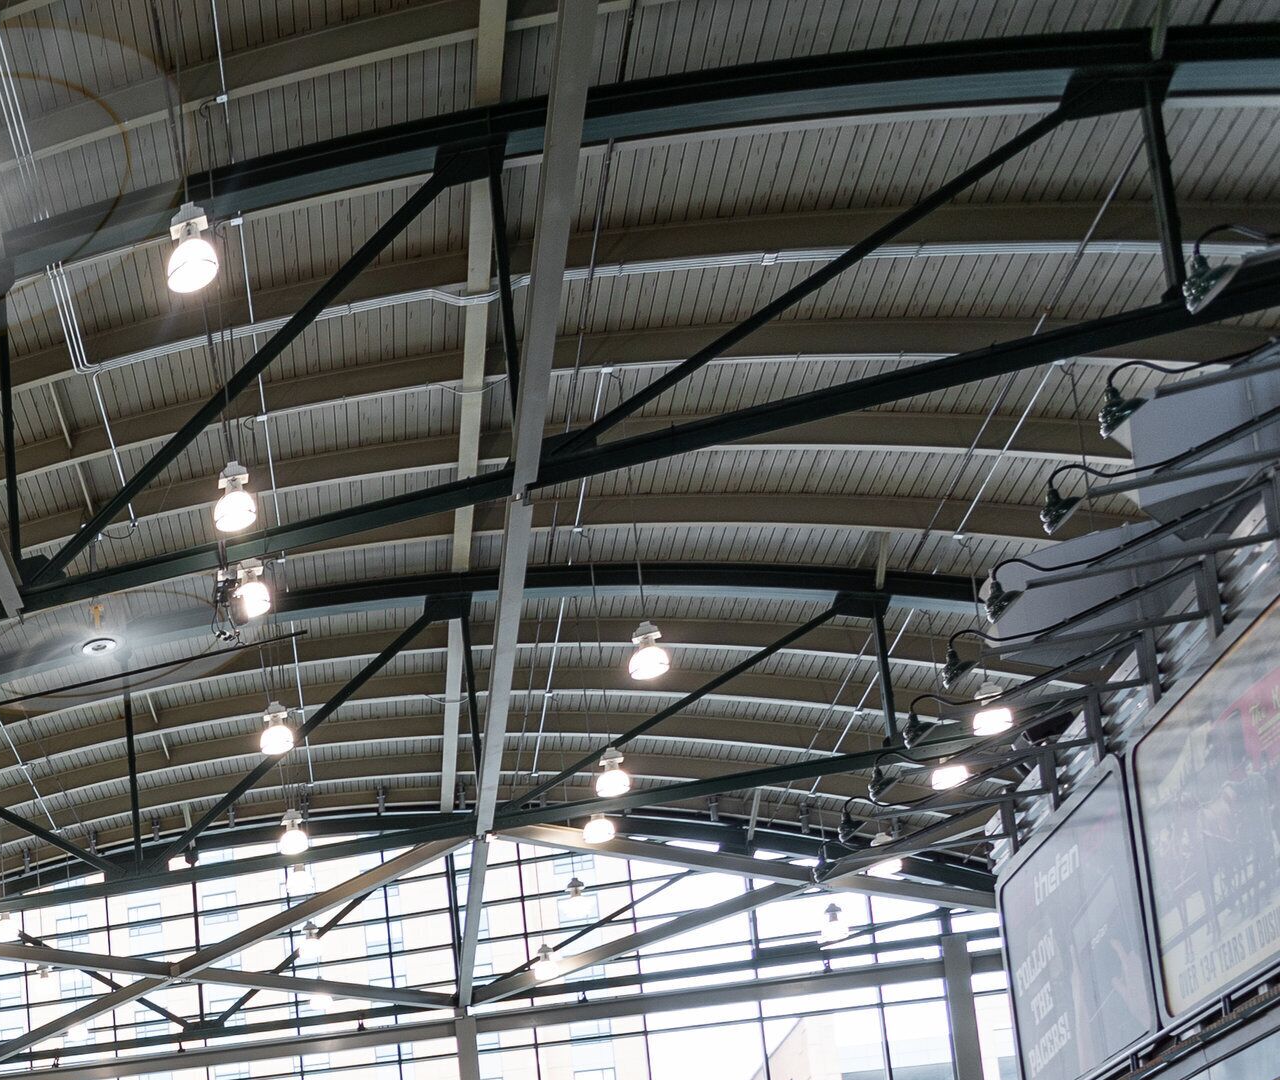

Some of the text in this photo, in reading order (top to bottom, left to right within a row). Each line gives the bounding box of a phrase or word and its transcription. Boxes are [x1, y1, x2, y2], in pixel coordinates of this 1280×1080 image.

[1015, 927, 1056, 998] FOLLOW
[1030, 981, 1054, 1026] THE
[1028, 1012, 1072, 1079] PACERS!
